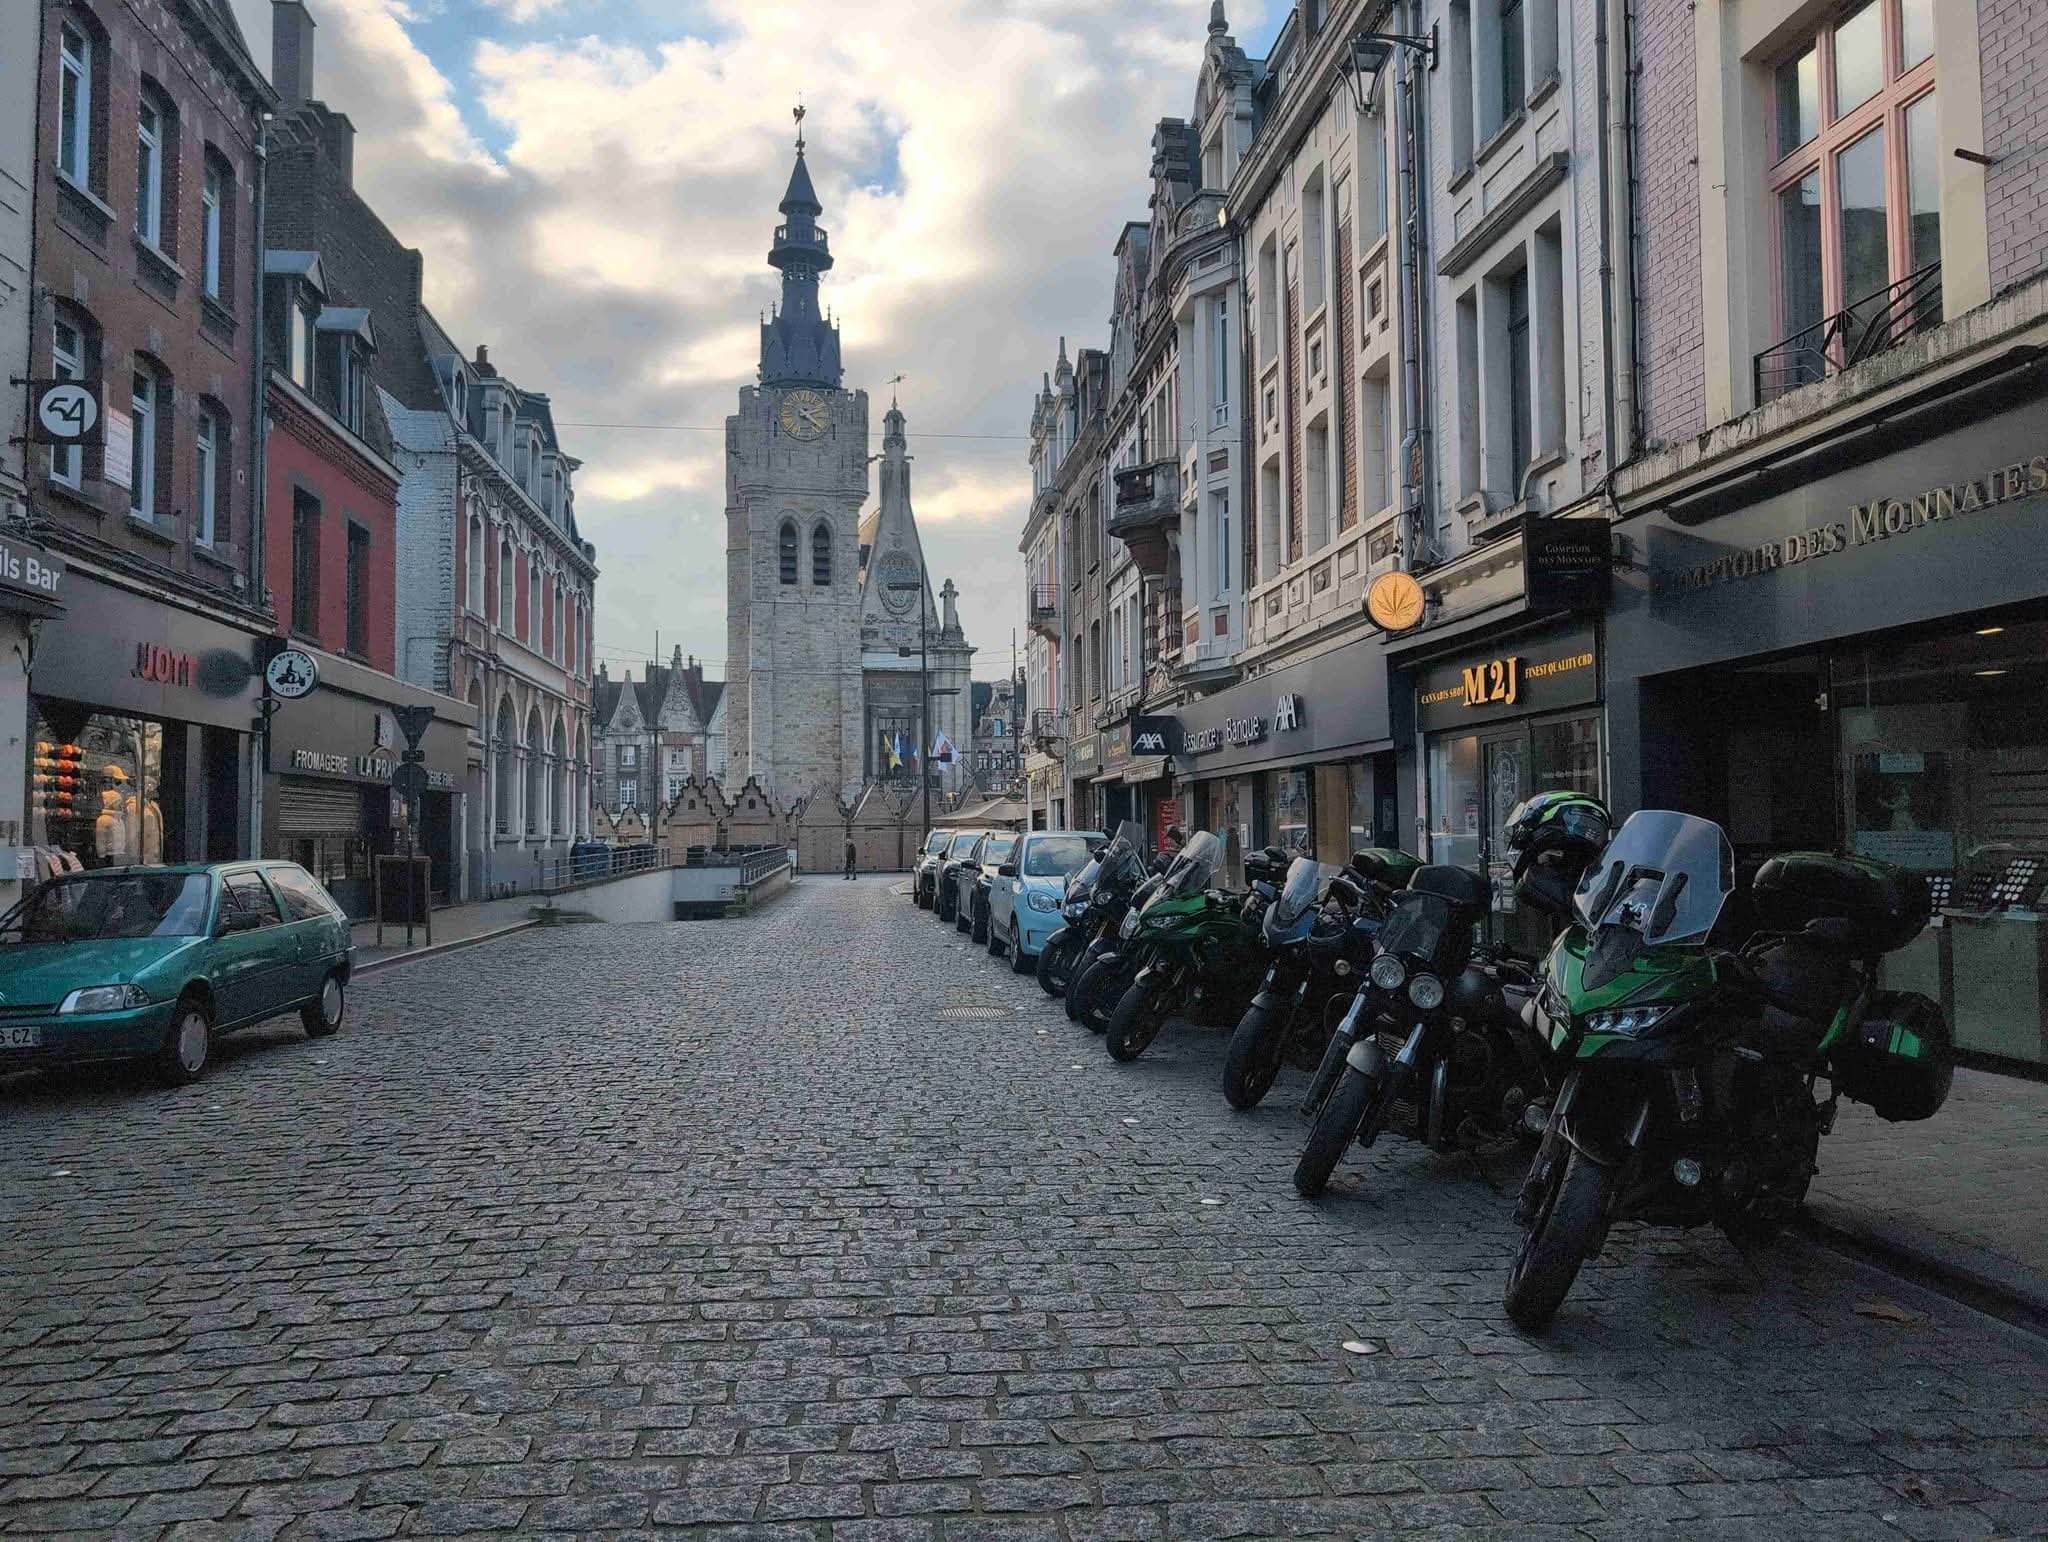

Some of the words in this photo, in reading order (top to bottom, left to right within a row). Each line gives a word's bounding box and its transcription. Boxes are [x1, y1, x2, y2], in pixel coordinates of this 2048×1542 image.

[1783, 523, 1837, 565] DES
[1848, 456, 2048, 546] MONNAIES
[26, 557, 60, 592] Bar
[1524, 663, 1548, 679] FINEST
[1547, 656, 1578, 676] QUALITY
[1182, 728, 1217, 753] Assurance
[1226, 715, 1260, 745] Banque
[1274, 692, 1298, 732] AXA
[1132, 732, 1165, 750] AXA
[296, 750, 348, 774] FROMAGERIE
[360, 756, 373, 777] LA
